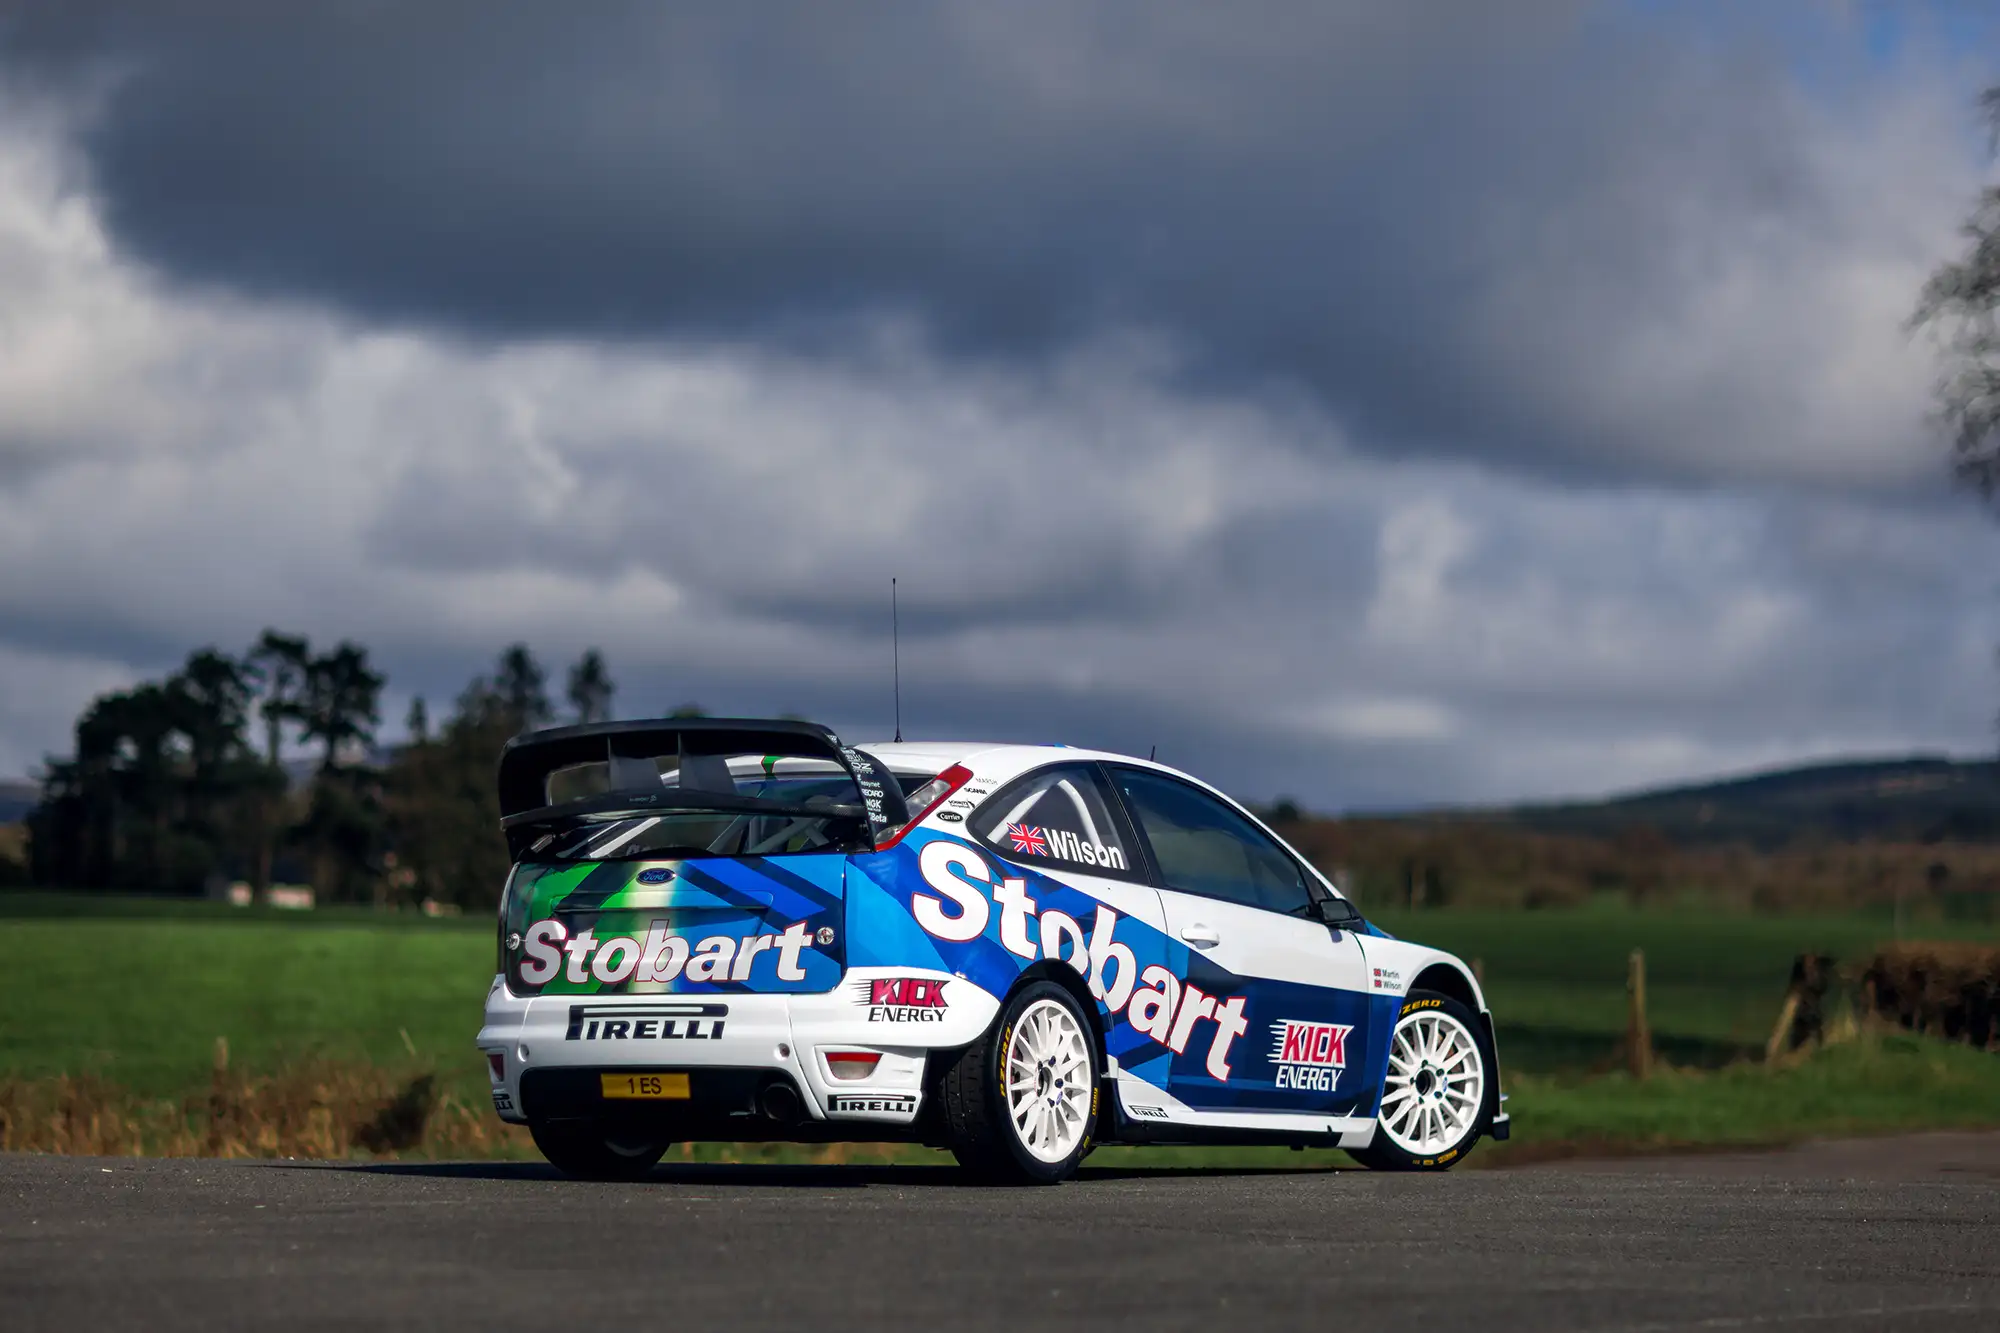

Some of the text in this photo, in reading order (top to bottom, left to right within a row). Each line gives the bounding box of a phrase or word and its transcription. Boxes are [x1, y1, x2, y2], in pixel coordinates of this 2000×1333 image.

[866, 799, 882, 809] NGK
[1042, 828, 1125, 870] Wilson
[520, 919, 814, 985] Stobart
[912, 840, 1248, 1082] Stobart
[868, 978, 950, 1008] KICK
[565, 1003, 729, 1040] PIRELLI
[868, 1007, 946, 1023] ENERGY
[1277, 1019, 1355, 1068] KICK
[628, 1077, 662, 1095] 1 ES
[1275, 1065, 1343, 1092] ENERGY
[827, 1093, 917, 1113] PIRELLI
[1128, 1104, 1170, 1119] PIRELLI
